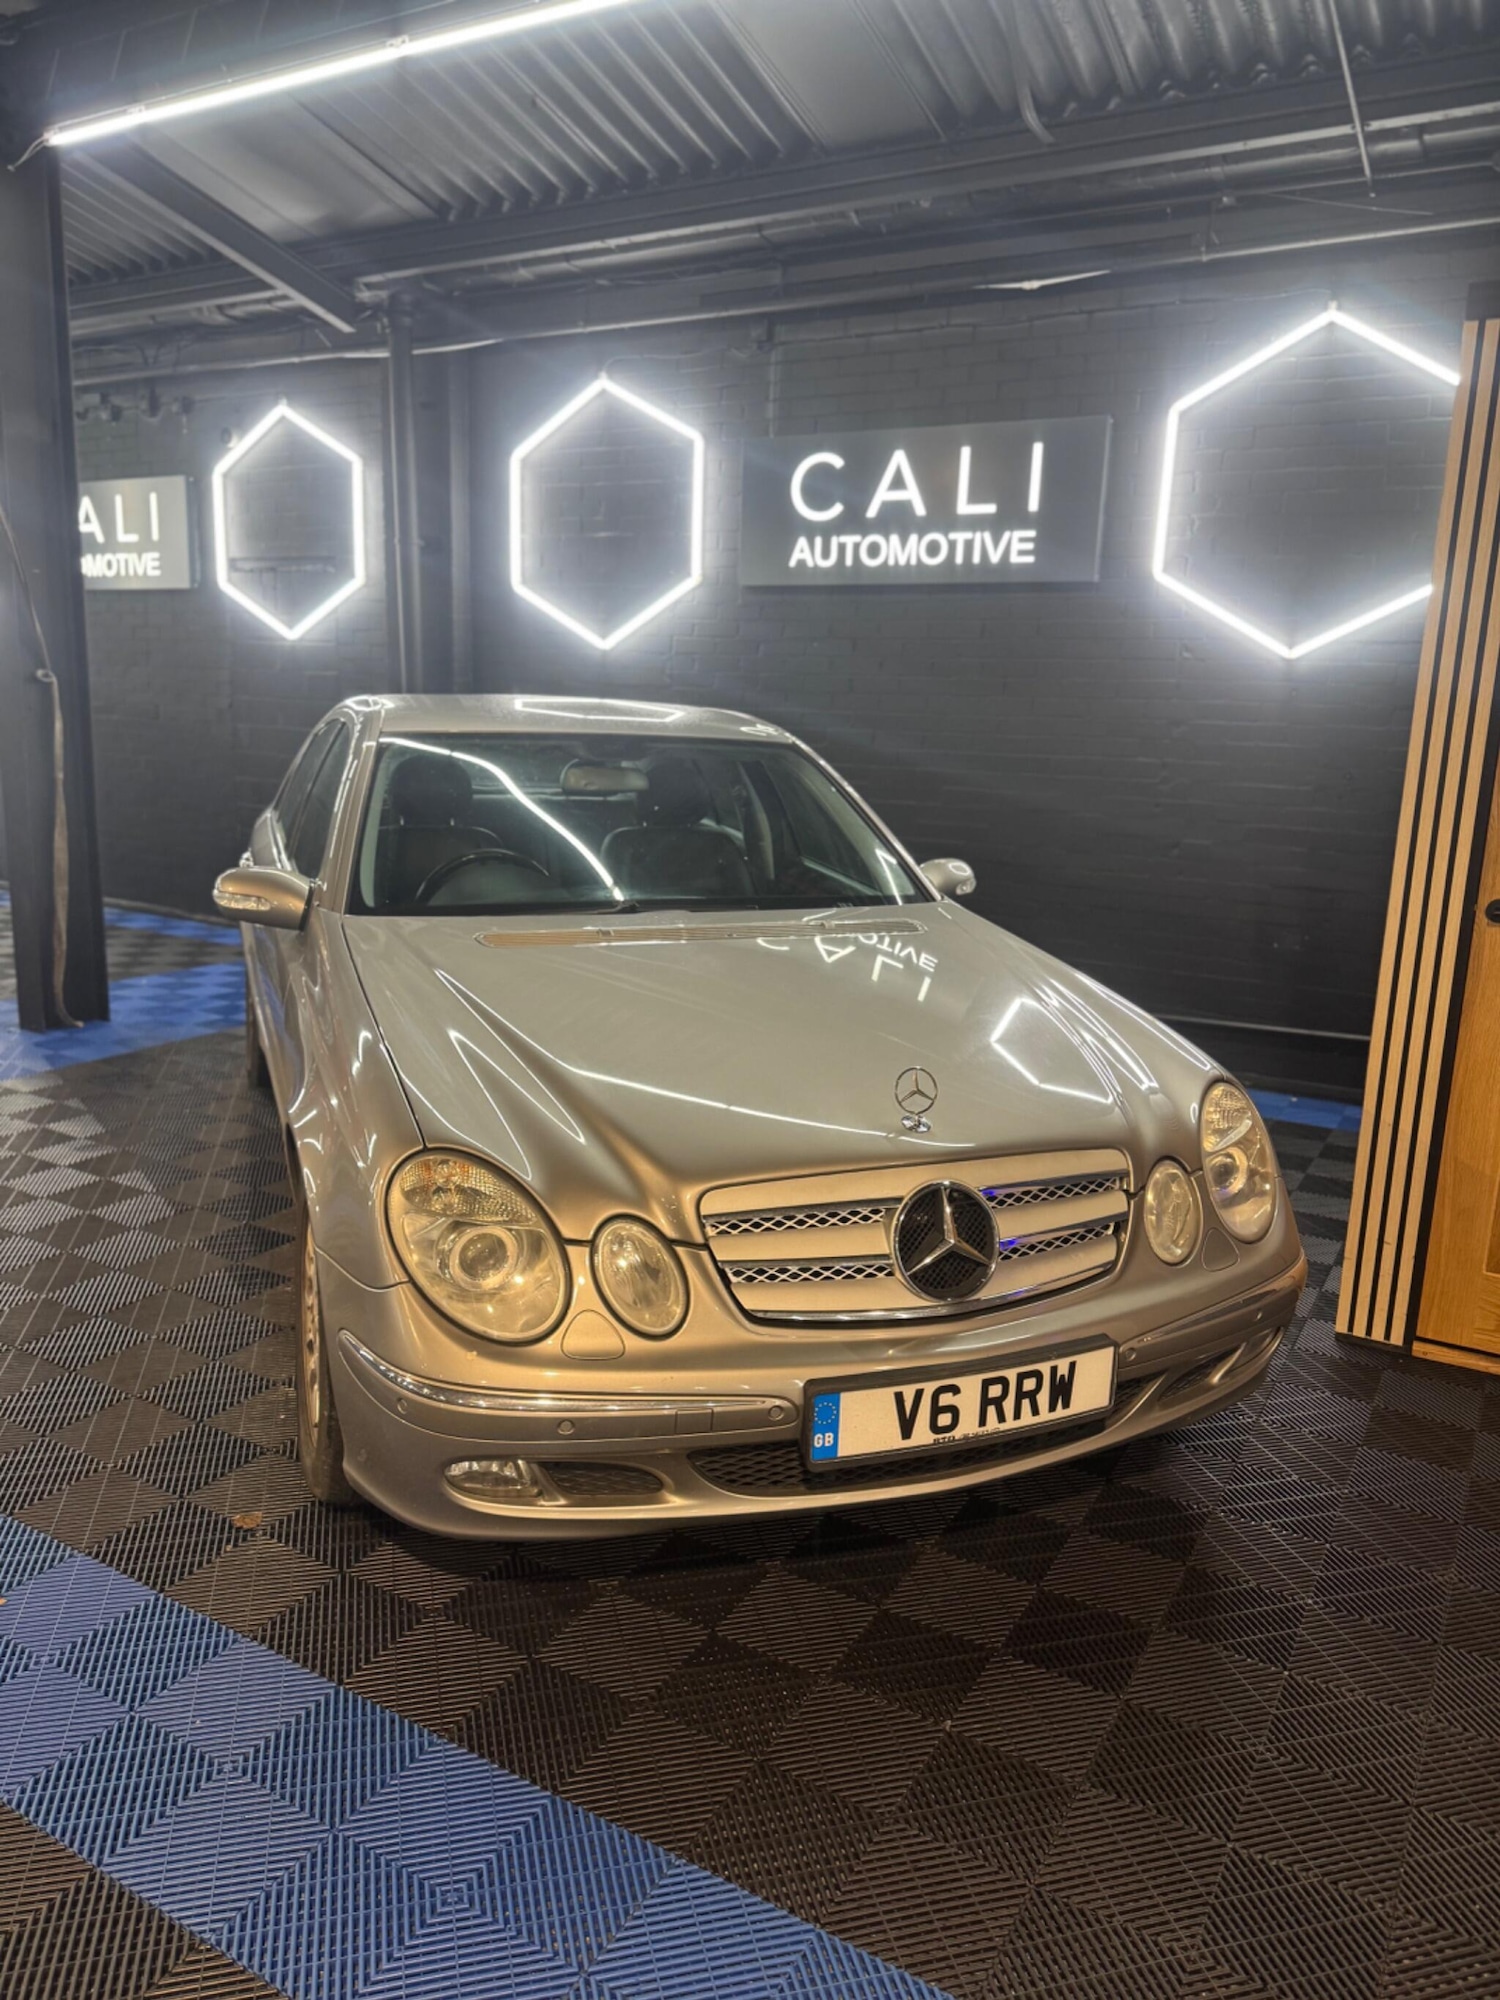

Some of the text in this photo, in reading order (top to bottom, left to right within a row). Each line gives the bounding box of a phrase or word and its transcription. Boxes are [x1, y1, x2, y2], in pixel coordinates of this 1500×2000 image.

[790, 441, 1044, 521] CALI
[788, 530, 1037, 568] AUTOMOTIVE
[893, 1361, 1077, 1440] V6 RRW
[813, 1433, 834, 1447] GB
